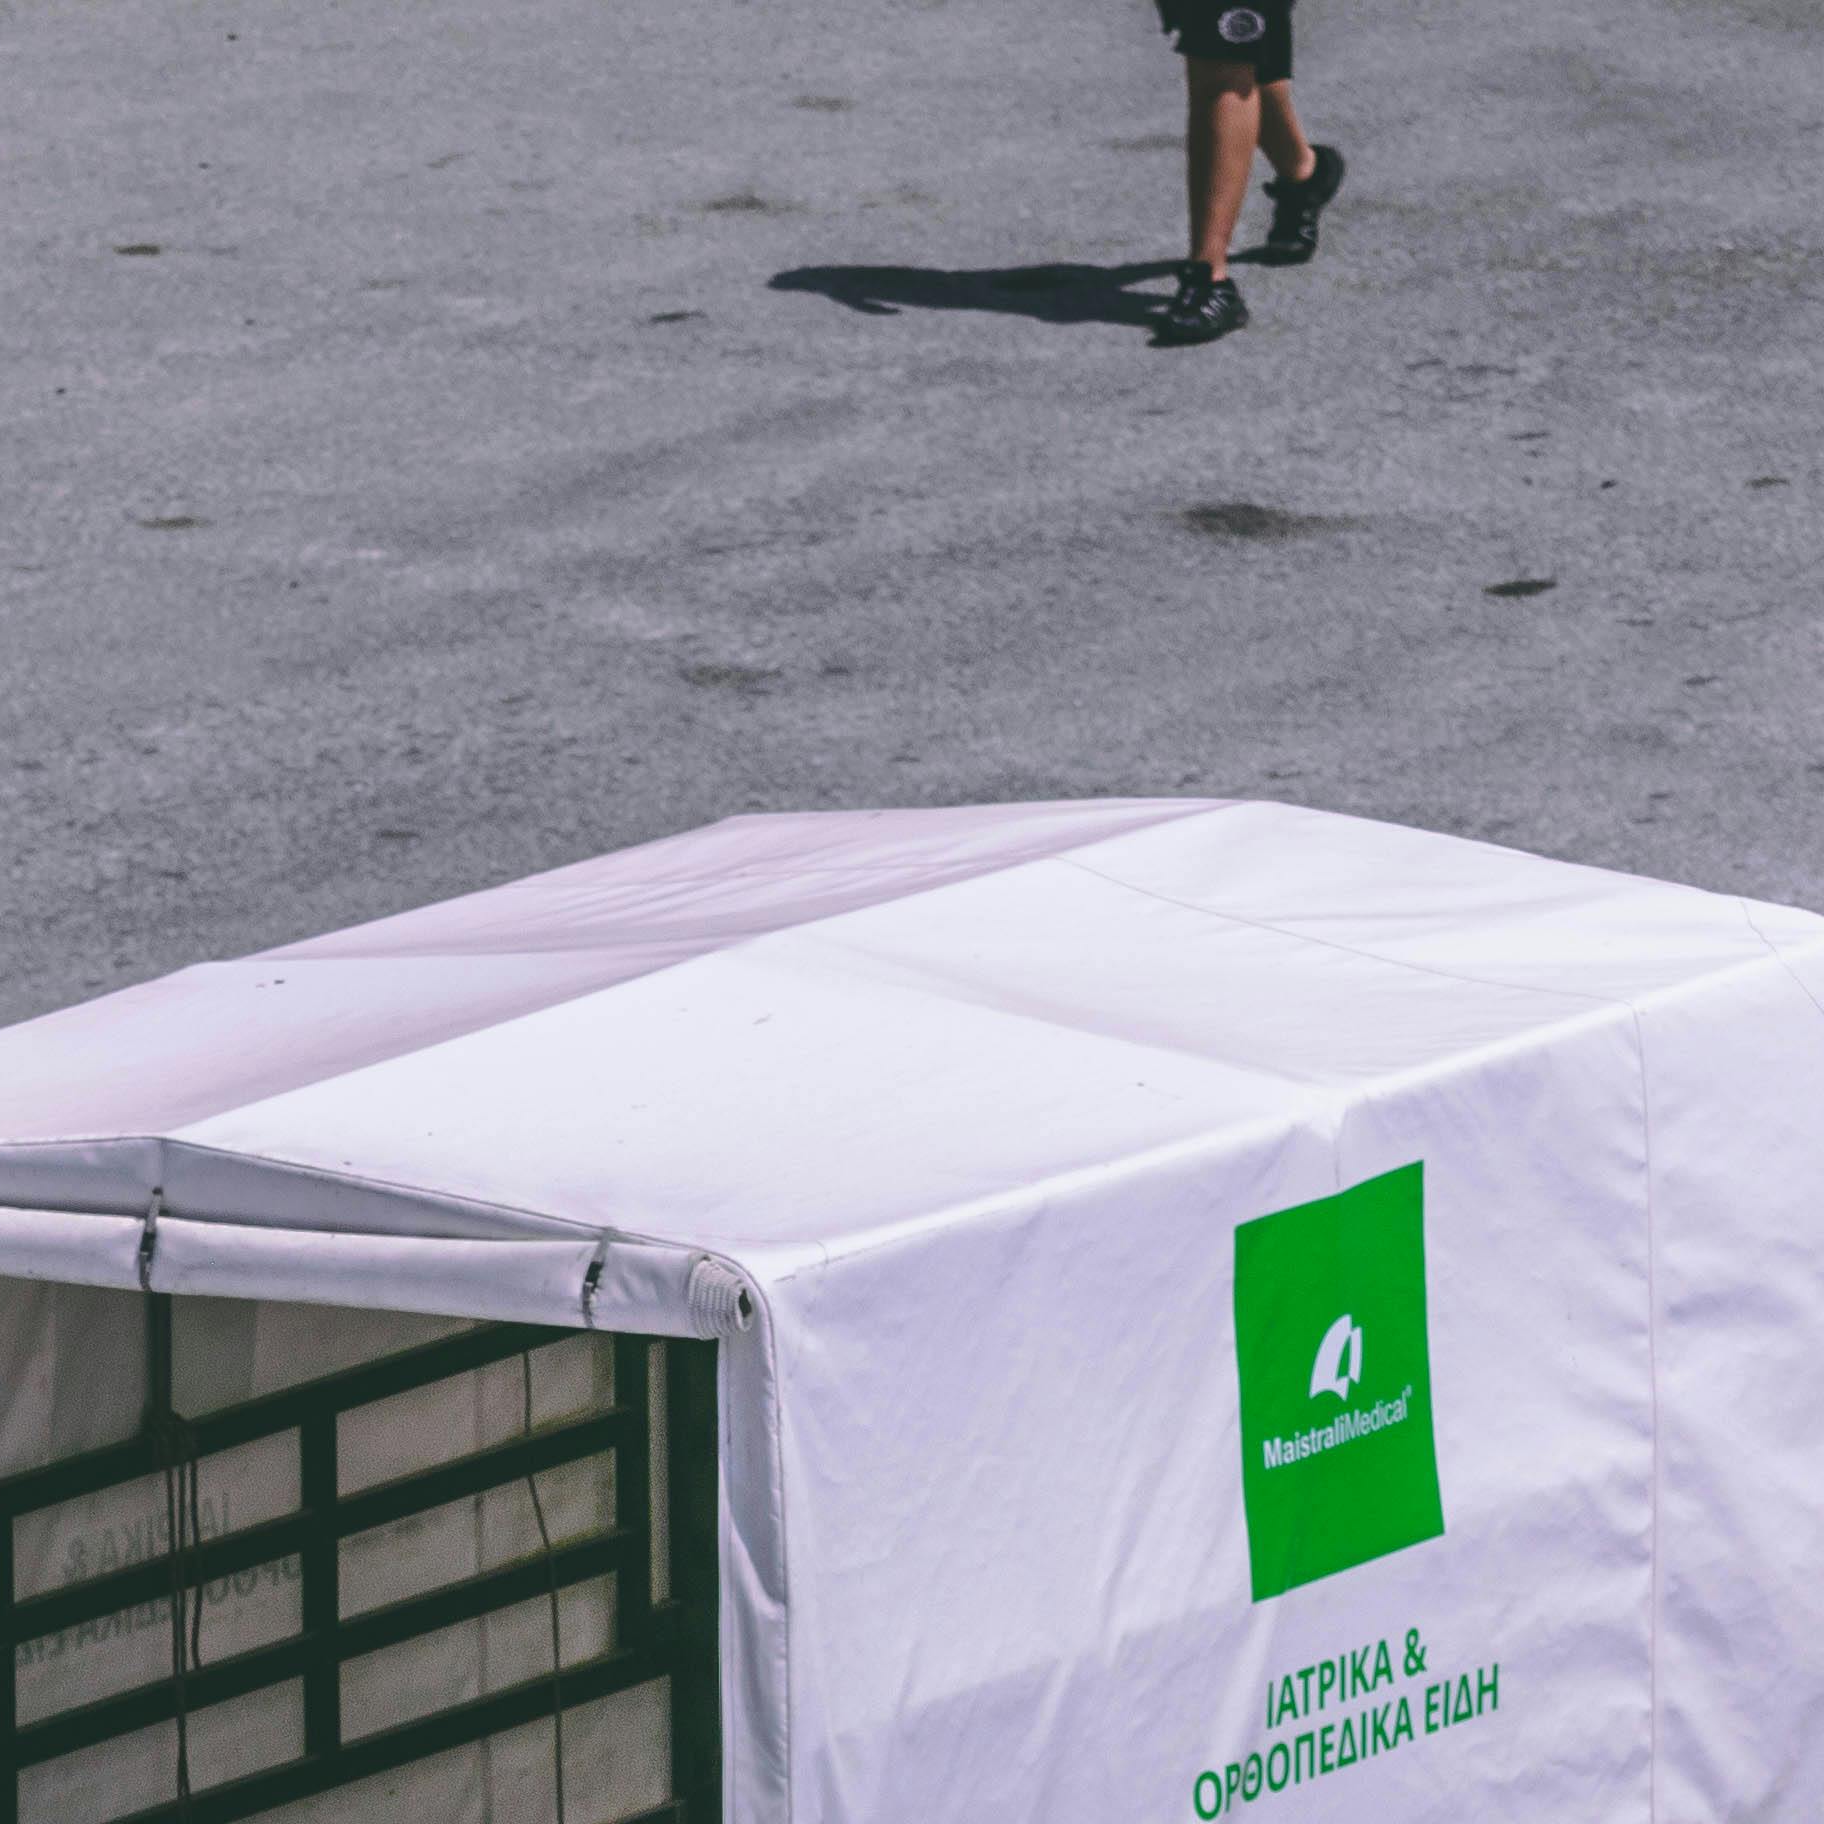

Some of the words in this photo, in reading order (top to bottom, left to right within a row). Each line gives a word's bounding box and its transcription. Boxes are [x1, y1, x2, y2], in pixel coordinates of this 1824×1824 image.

[1192, 1697, 1414, 1822] ΟΡΘΟΠΕΔΙΚΑ
[1425, 1663, 1500, 1736] ΕΙΔΗ
[1266, 1639, 1394, 1730] ΙΑΤΡΙΚΑ
[1403, 1627, 1428, 1679] &
